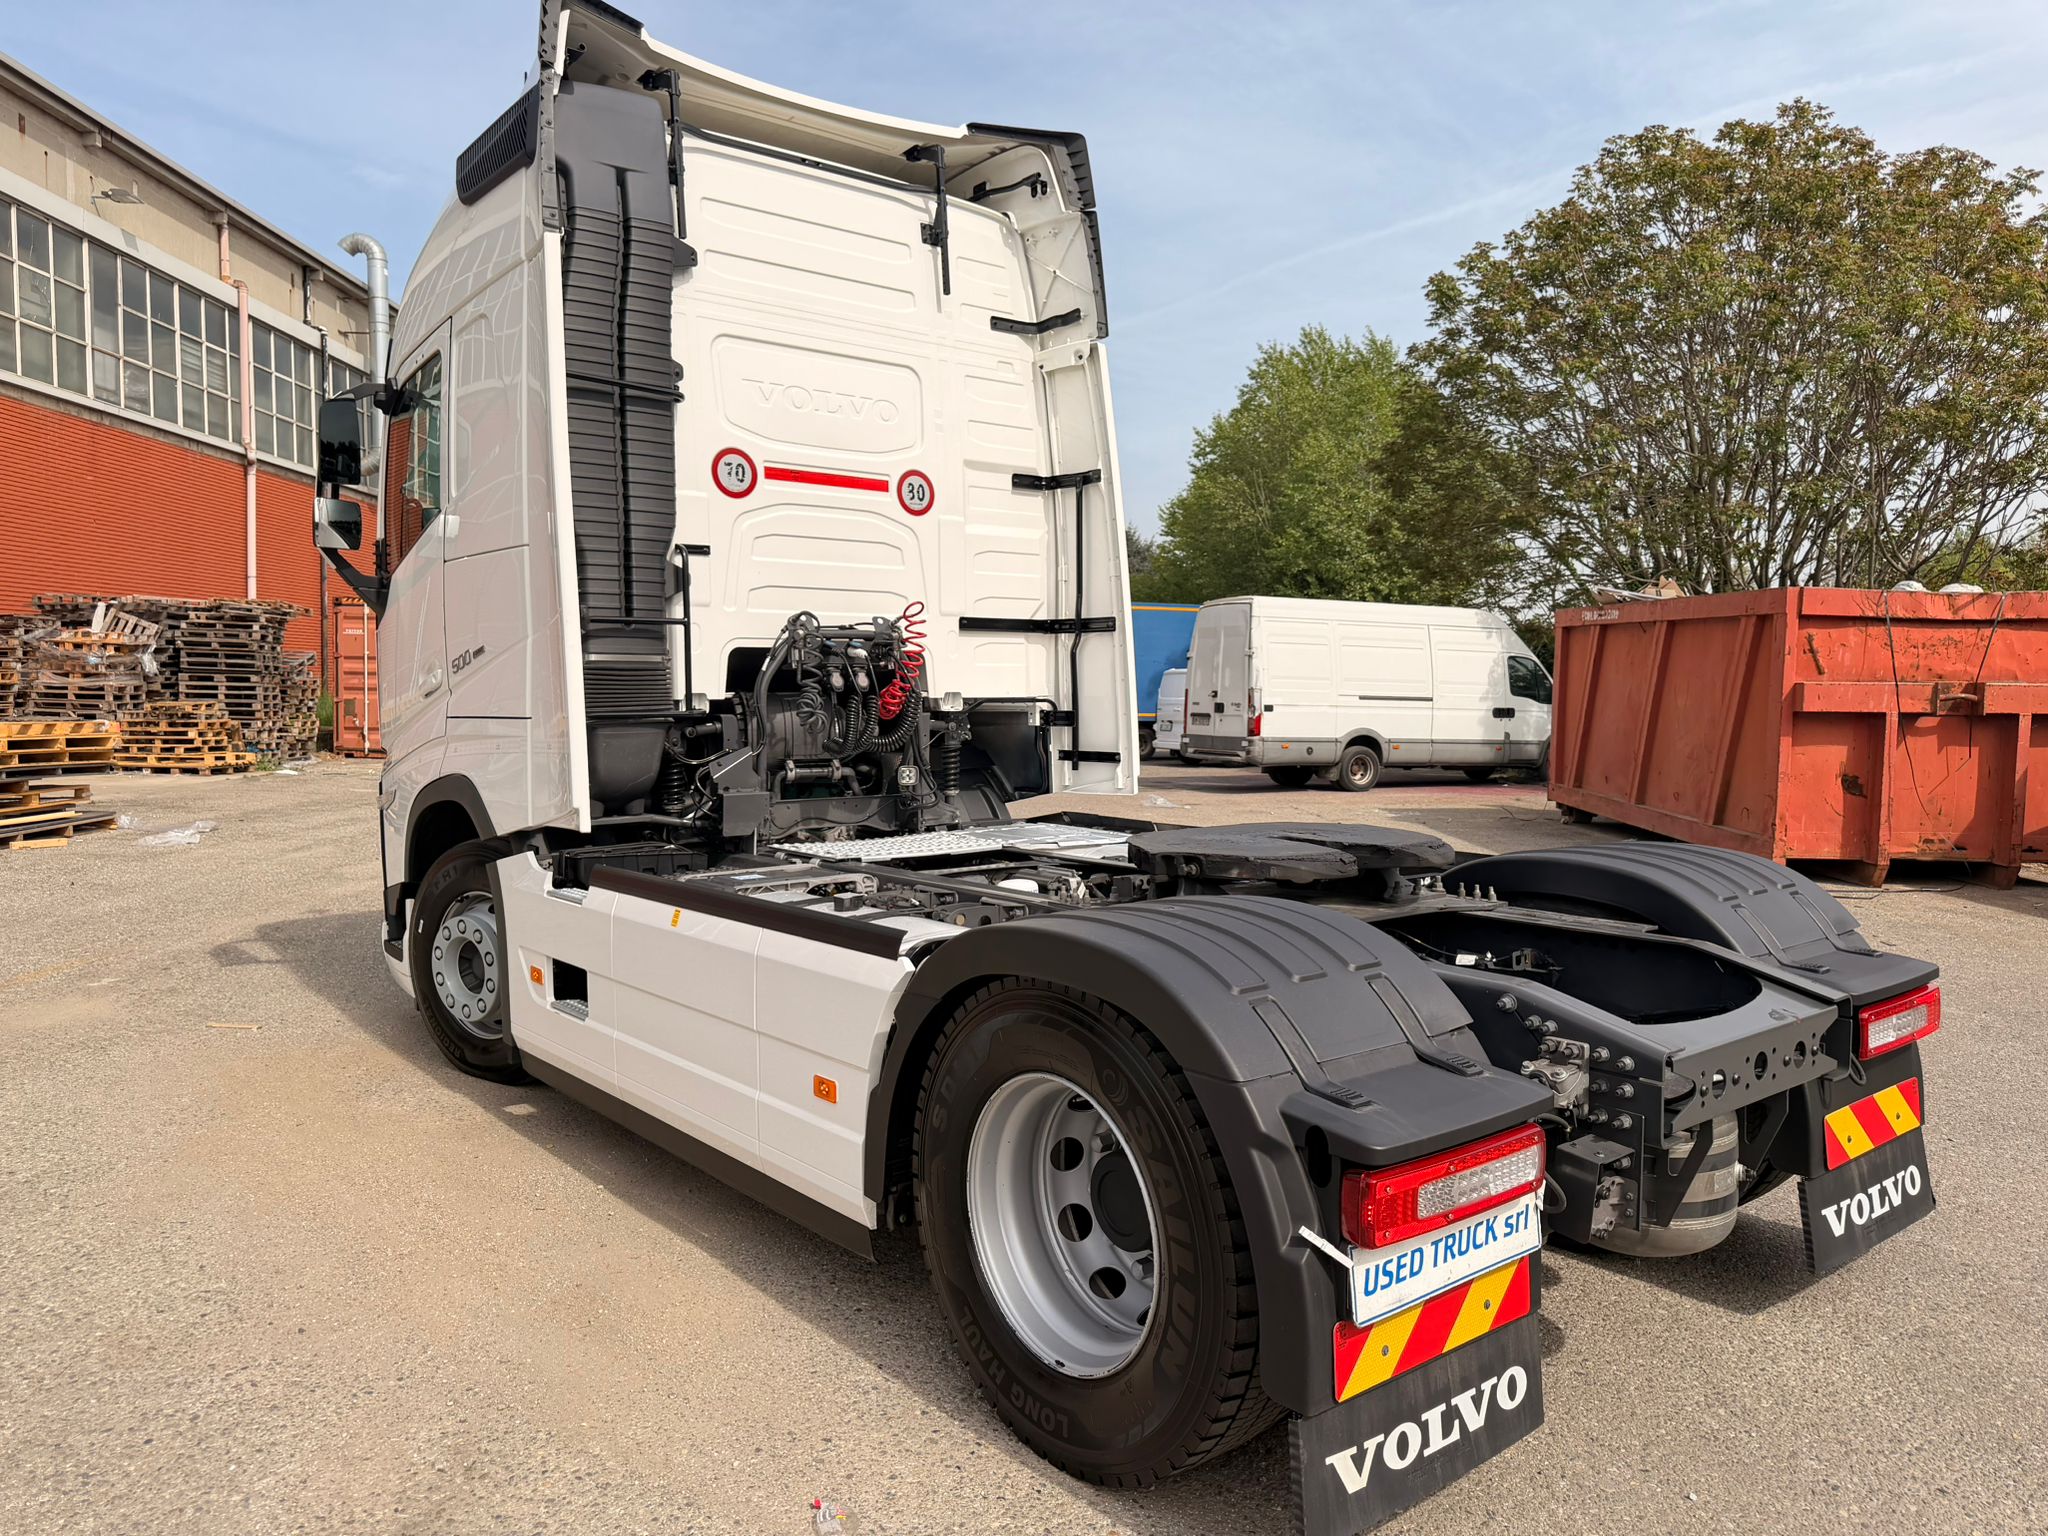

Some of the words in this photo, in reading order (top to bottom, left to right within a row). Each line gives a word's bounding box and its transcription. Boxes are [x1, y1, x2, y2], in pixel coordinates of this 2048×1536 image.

[741, 378, 899, 424] VOLVO
[451, 648, 471, 674] 500
[1821, 1165, 1921, 1237] VOLVO
[1127, 1105, 1197, 1383] SAILUN
[1364, 1247, 1424, 1297] USED
[1431, 1215, 1498, 1268] TRUCK
[1503, 1203, 1530, 1239] srl
[959, 1304, 1006, 1385] HAUL
[1010, 1382, 1069, 1438] LONG
[1325, 1365, 1528, 1494] VOLVO
